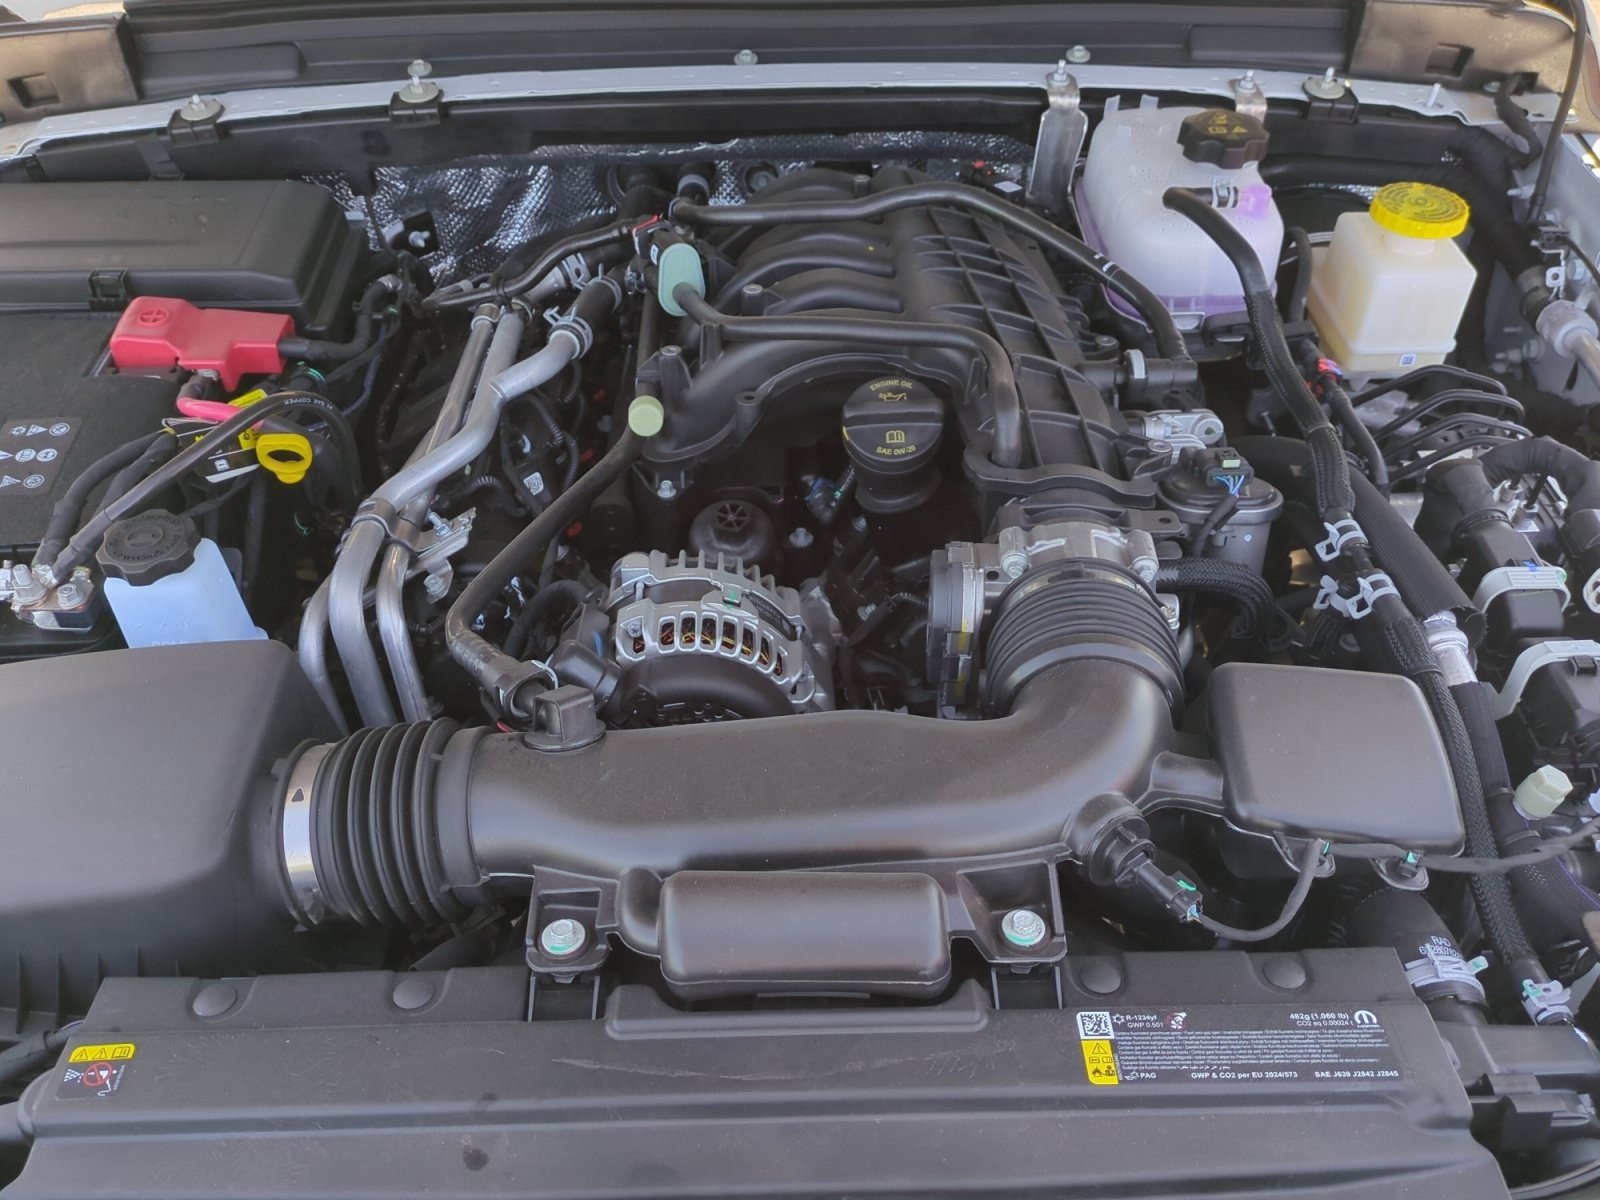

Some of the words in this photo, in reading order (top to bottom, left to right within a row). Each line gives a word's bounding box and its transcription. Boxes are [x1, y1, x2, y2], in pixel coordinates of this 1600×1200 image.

[869, 379, 900, 391] ENGINE
[900, 380, 913, 389] OIL
[283, 397, 311, 405] COPPER
[876, 446, 893, 455] SAE
[893, 445, 916, 455] 0W-20
[1430, 935, 1451, 947] RAD
[1125, 1014, 1157, 1022] R-1234yf
[1289, 1013, 1311, 1021] 482g
[1337, 1012, 1349, 1020] lb)
